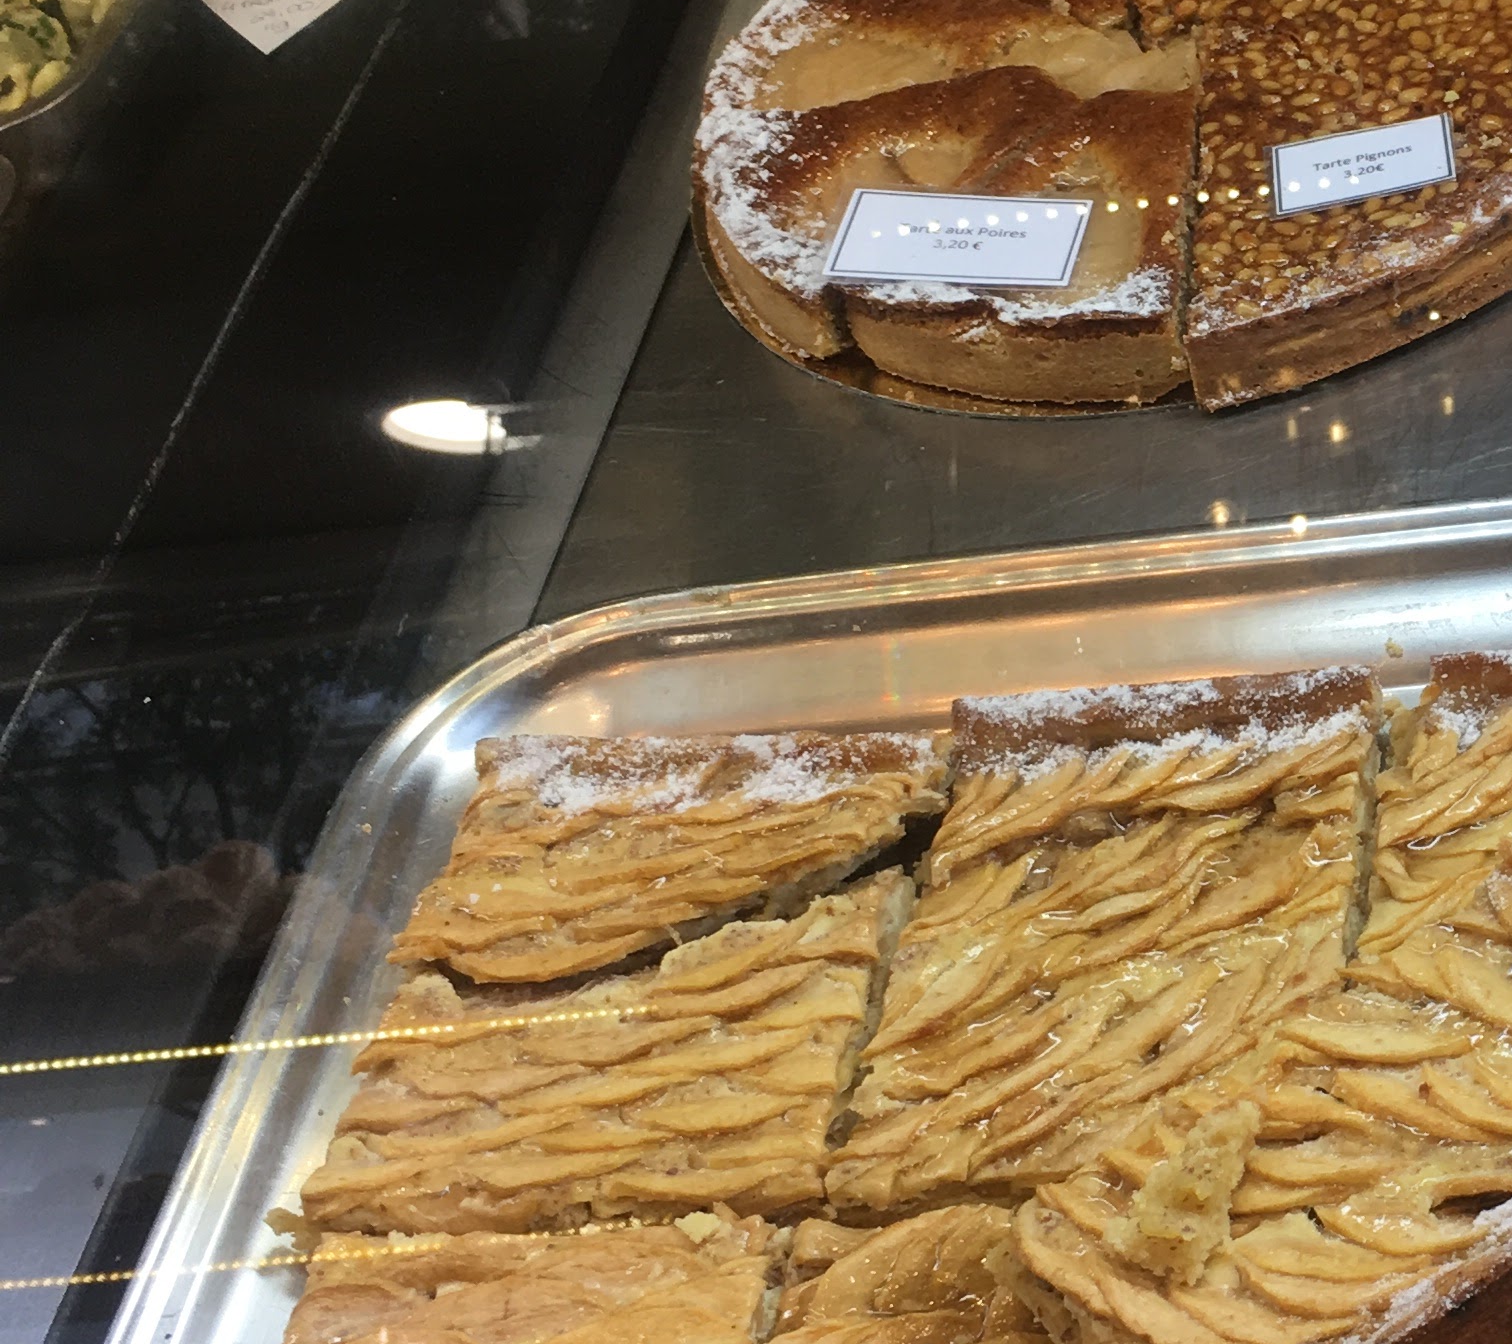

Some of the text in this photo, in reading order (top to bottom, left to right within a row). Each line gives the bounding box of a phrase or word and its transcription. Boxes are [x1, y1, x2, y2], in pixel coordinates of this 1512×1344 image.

[1312, 144, 1413, 172] Tarte Pignons
[1343, 163, 1385, 179] 320€
[899, 220, 1027, 239] art aux Poires
[933, 238, 984, 251] 3,20 €
